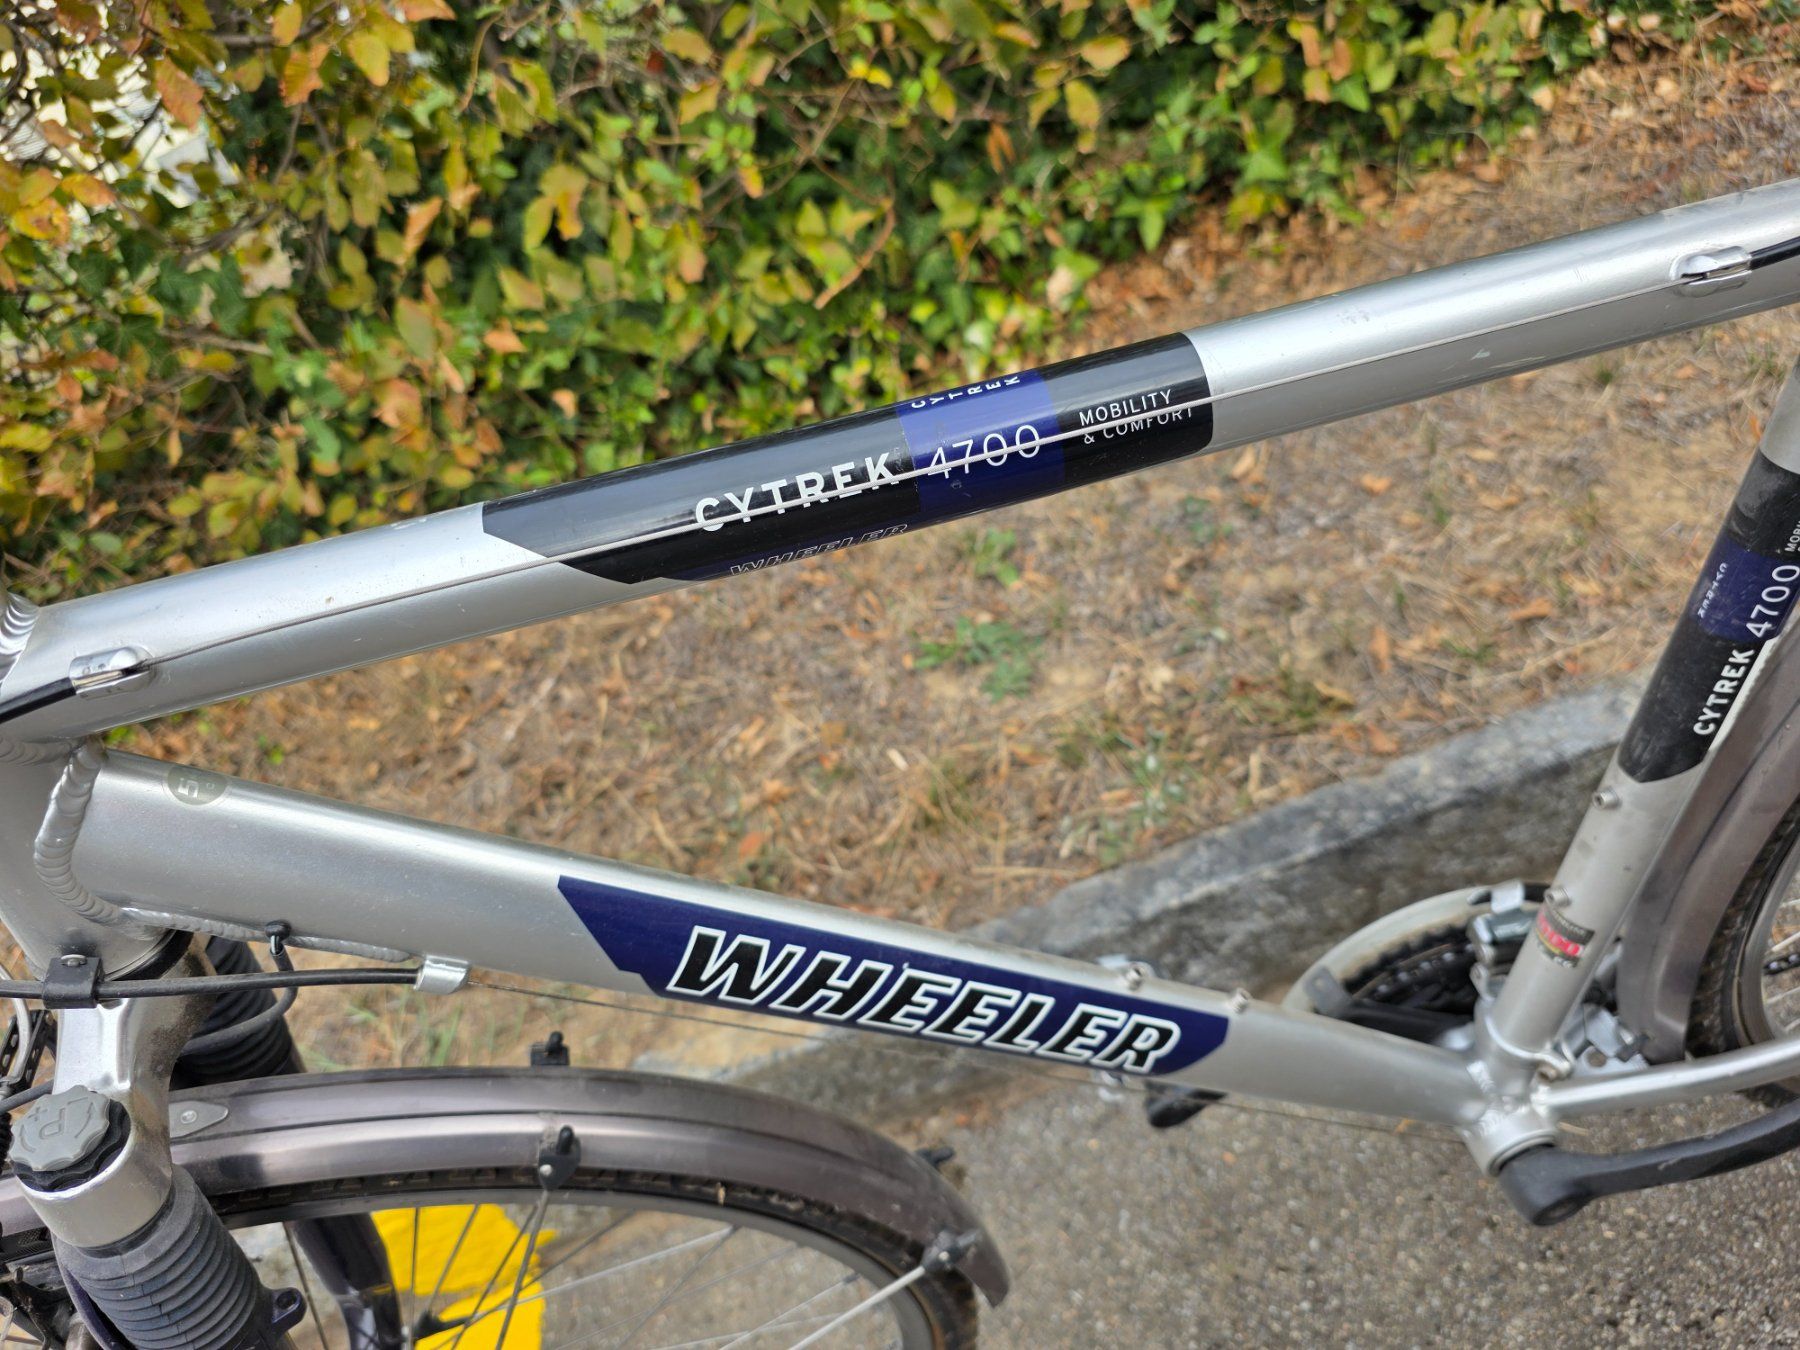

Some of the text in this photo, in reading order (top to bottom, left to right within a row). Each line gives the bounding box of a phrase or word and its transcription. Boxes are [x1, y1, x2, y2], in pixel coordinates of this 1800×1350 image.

[911, 376, 1020, 408] CYTREK
[1079, 388, 1172, 426] MOBILITY
[695, 424, 1040, 532] CYTREK 4700
[1697, 562, 1728, 619] CYTREK
[1693, 564, 1800, 736] CYTREK 4700
[666, 925, 1181, 1075] WHEELER
